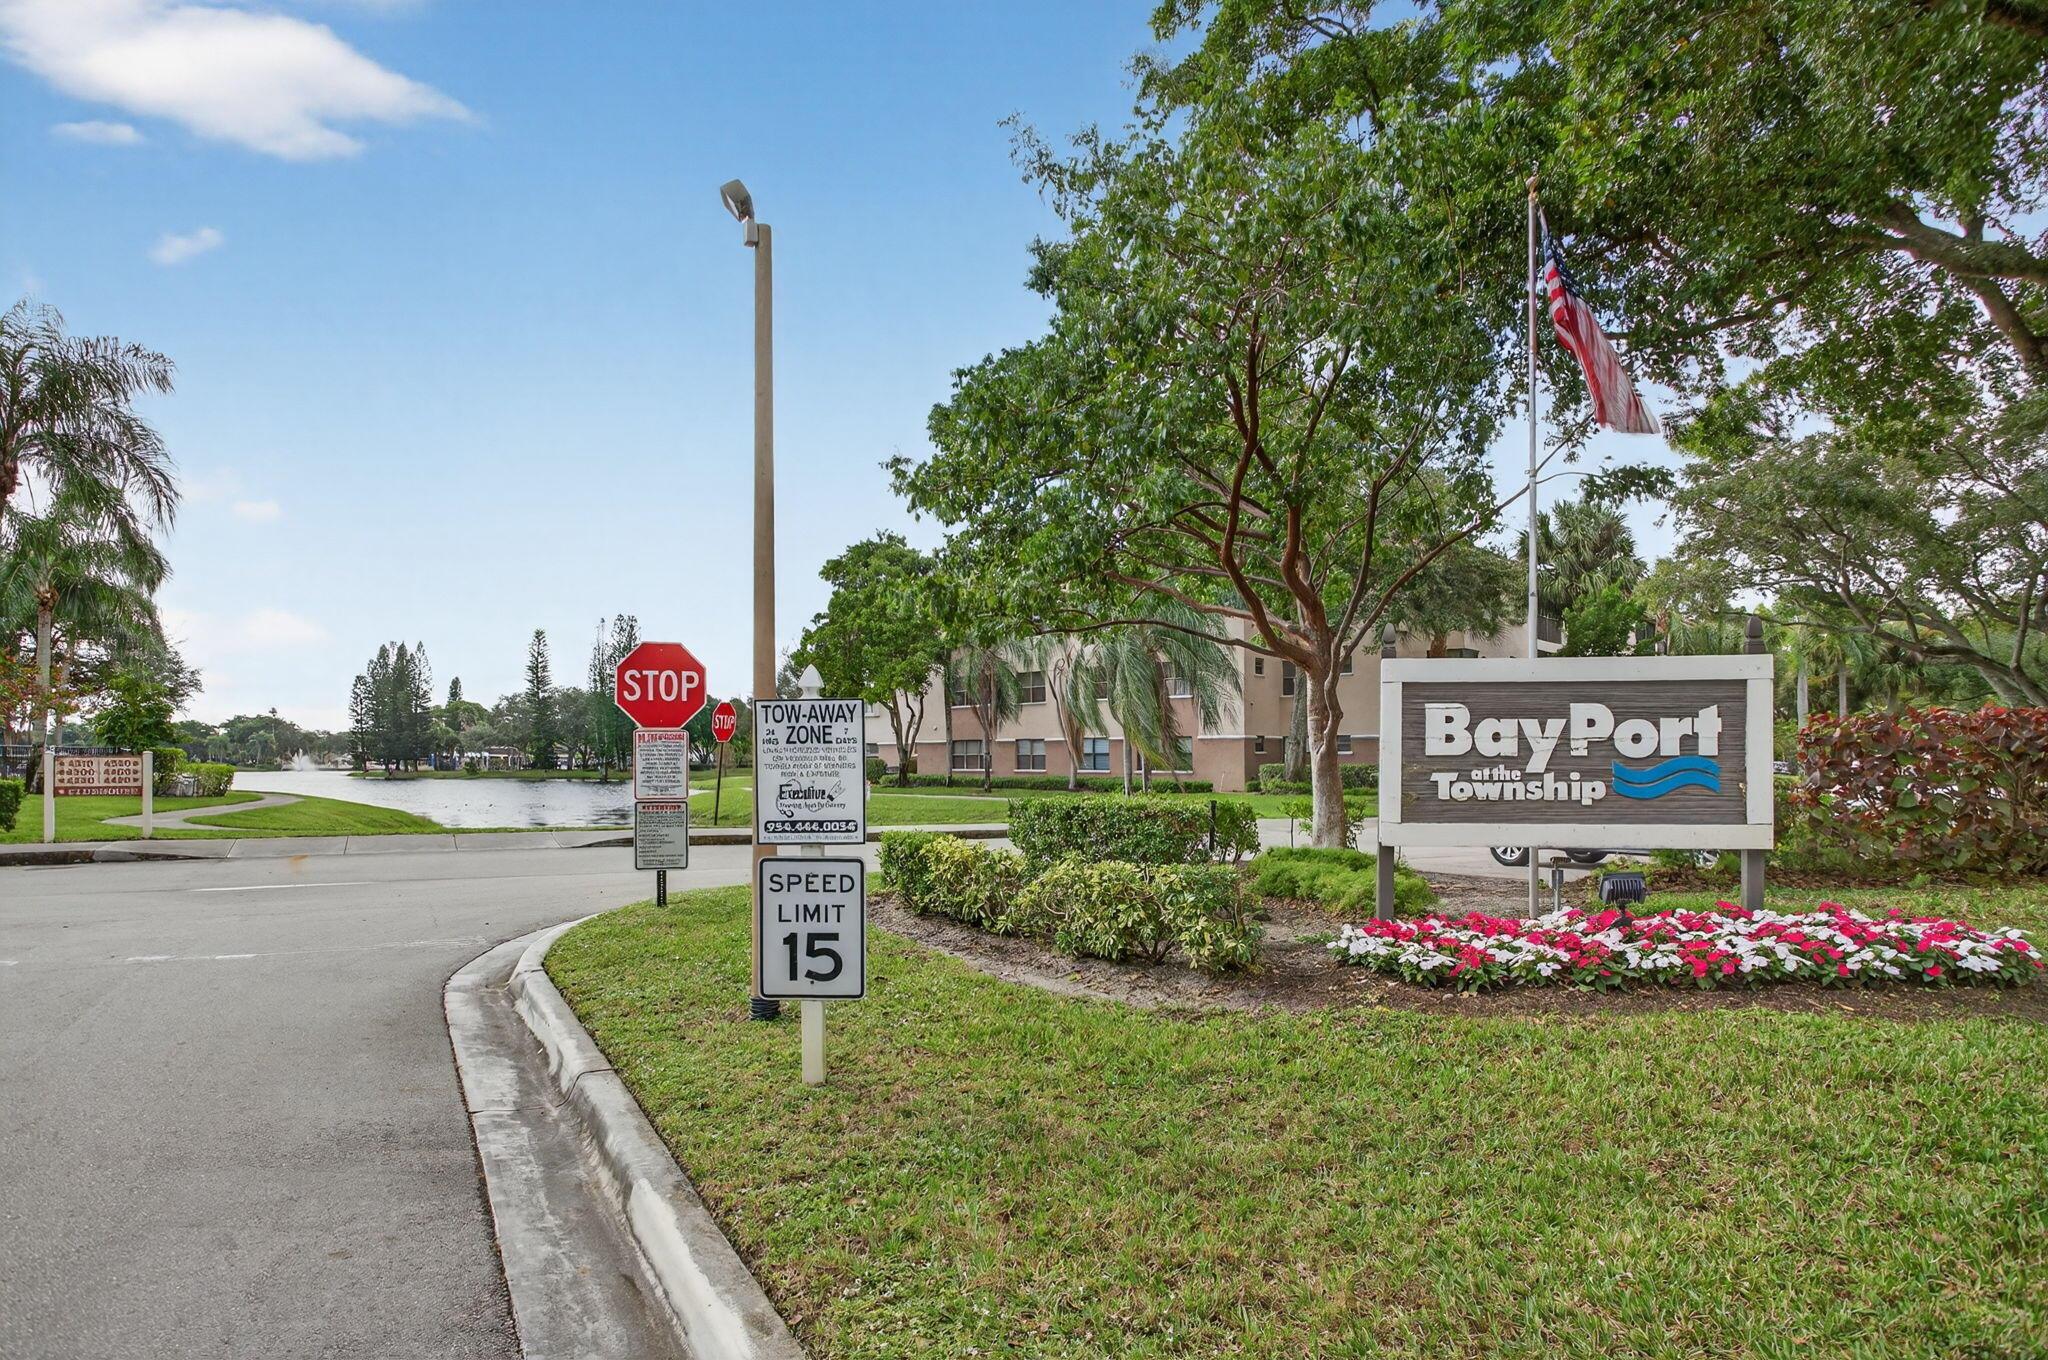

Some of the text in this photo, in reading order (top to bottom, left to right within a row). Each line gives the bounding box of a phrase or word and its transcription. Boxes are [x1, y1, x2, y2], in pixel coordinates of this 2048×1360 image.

[623, 669, 699, 701] STOP
[714, 714, 735, 729] STOP
[760, 703, 857, 724] TOW-AWAY
[785, 725, 834, 745] ZONE
[1430, 772, 1606, 805] Township
[769, 873, 855, 893] SPEED
[778, 904, 846, 923] LIMIT
[783, 932, 843, 982] 15
